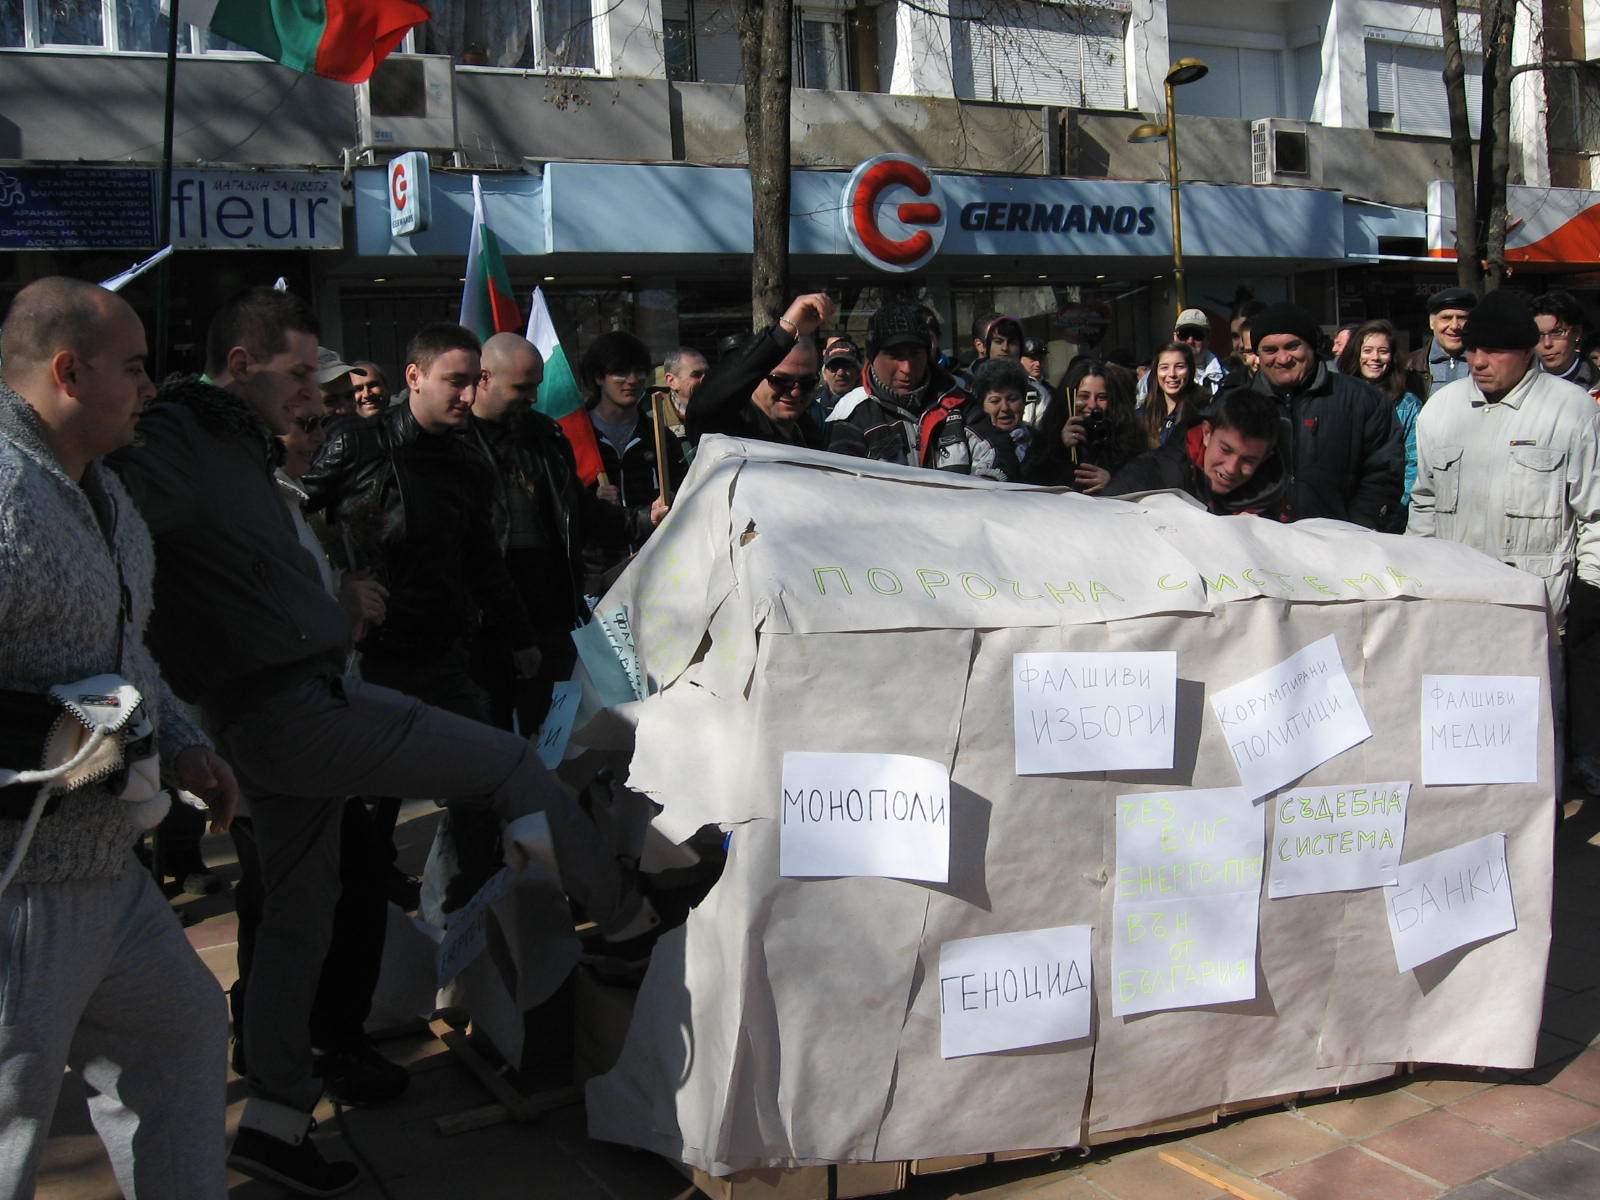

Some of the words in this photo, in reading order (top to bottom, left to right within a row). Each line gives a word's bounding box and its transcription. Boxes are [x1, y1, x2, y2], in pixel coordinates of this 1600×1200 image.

[213, 180, 270, 192] МАГАЗИН
[273, 180, 288, 192] ЗА
[291, 180, 328, 192] ЦВЕТЯ
[171, 179, 328, 239] fleur
[960, 202, 1156, 235] GERMANOS
[812, 566, 1124, 604] ПОРОЧНА
[1157, 566, 1422, 596] СИСТЕМА
[1018, 660, 1151, 695] ФАЛШИВИ
[1216, 661, 1328, 730] КОРУМПИРАНИ
[1430, 681, 1516, 712] ФАЛШИВИ
[1031, 704, 1168, 745] ИЗБОРИ
[1231, 695, 1343, 768] ПОЛИТИЦИ
[1430, 723, 1512, 750] МЕДИИ
[783, 788, 946, 826] МОНОПОЛИ
[1280, 789, 1402, 824] СЪДЕБНА
[1279, 828, 1394, 861] СИСТЕМА
[1391, 857, 1509, 933] БАНКИ
[940, 959, 1088, 1014] ГЕНОЦИД
[1119, 960, 1248, 1004] БЪЛГАРИЯ
